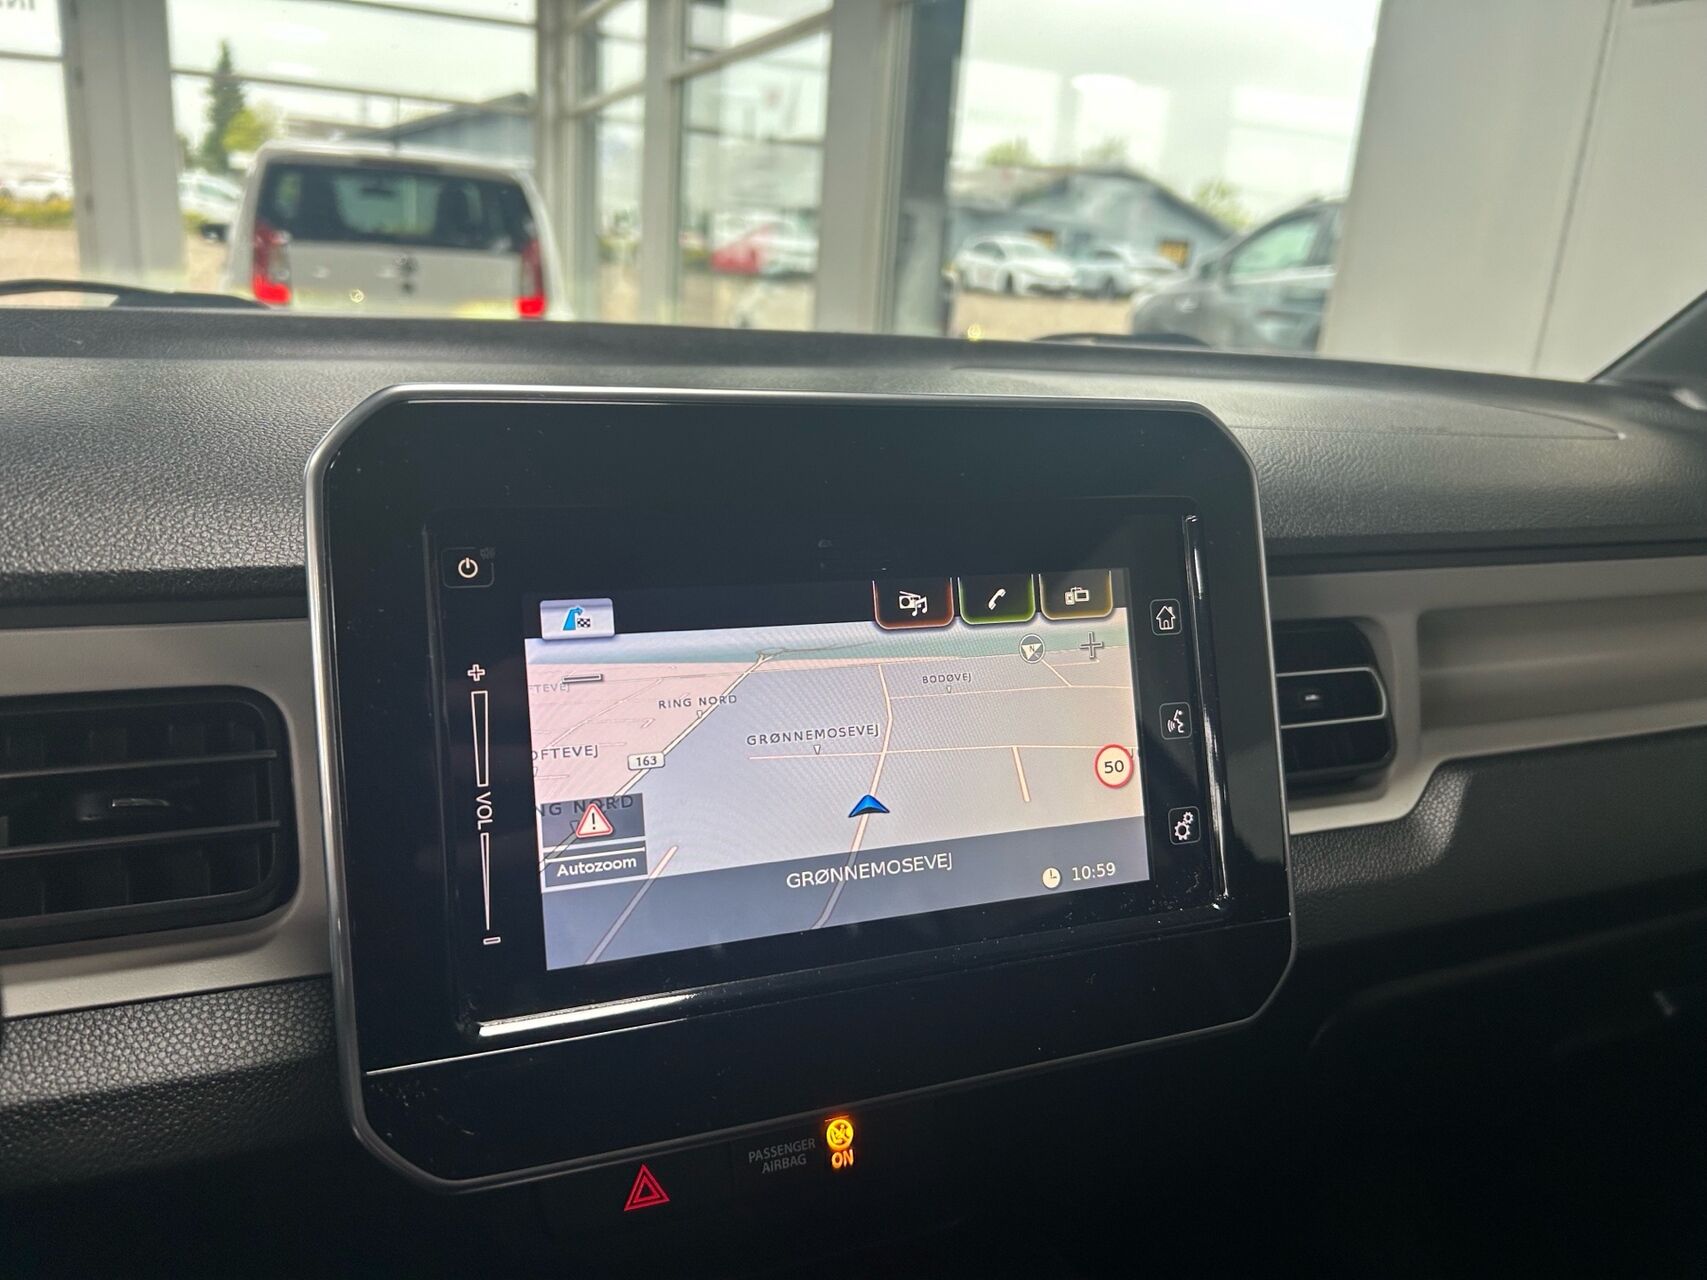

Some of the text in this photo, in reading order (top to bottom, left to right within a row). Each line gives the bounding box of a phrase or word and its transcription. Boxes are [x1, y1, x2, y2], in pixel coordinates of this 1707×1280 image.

[922, 672, 972, 684] BODØVEJ
[658, 695, 738, 709] RING NORD
[746, 723, 880, 746] GRØNNEMOSEVEJ
[636, 755, 657, 767] 163
[1104, 759, 1125, 774] 50
[475, 791, 493, 830] VOL
[557, 857, 637, 877] Autozoom
[786, 852, 953, 889] GRØNNEMOSEVEJ
[1071, 862, 1116, 881] 10:59
[747, 1137, 816, 1163] PASSENGER
[831, 1148, 854, 1169] ON
[762, 1153, 807, 1174] AIRBAG
